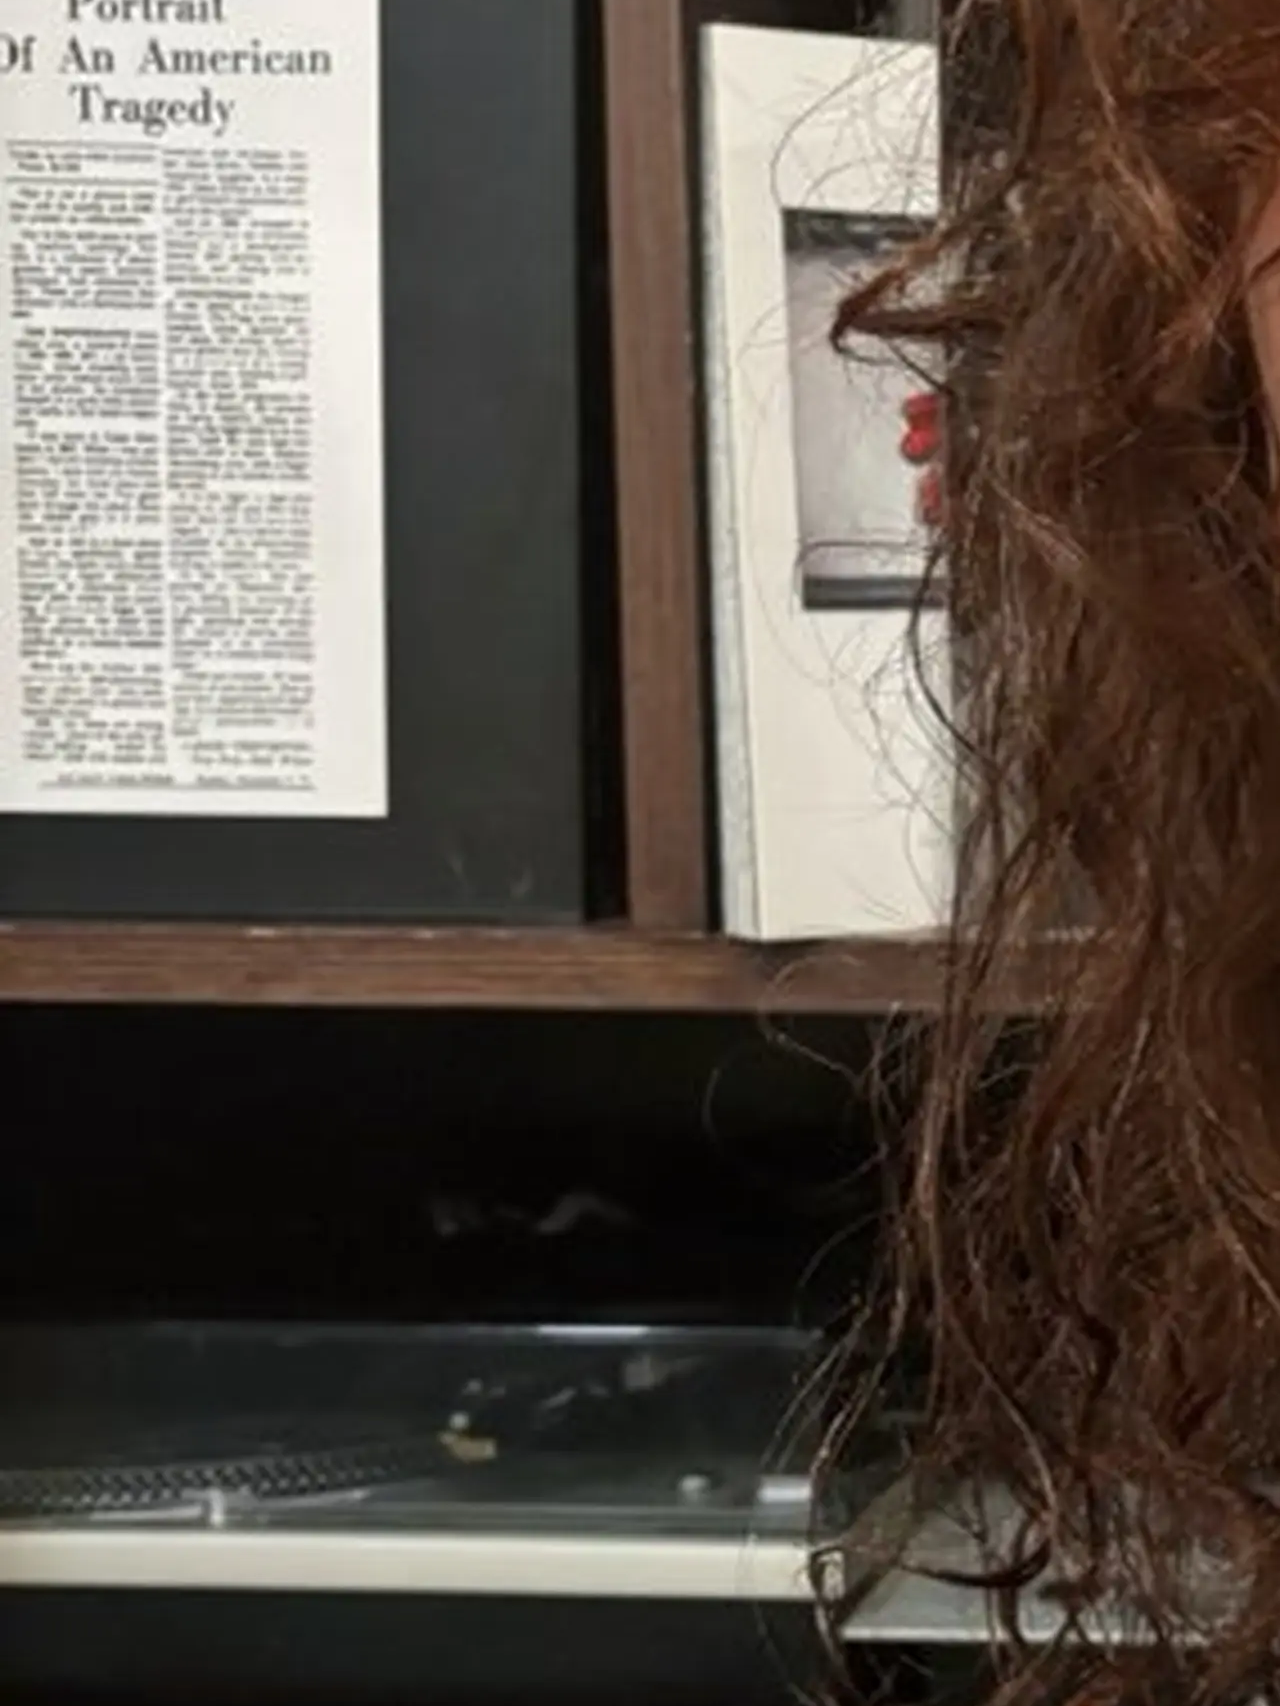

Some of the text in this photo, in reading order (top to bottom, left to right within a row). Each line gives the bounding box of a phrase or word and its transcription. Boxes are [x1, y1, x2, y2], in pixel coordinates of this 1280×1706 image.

[58, 35, 114, 75] An
[138, 36, 333, 76] American
[68, 82, 234, 138] Tragedy
